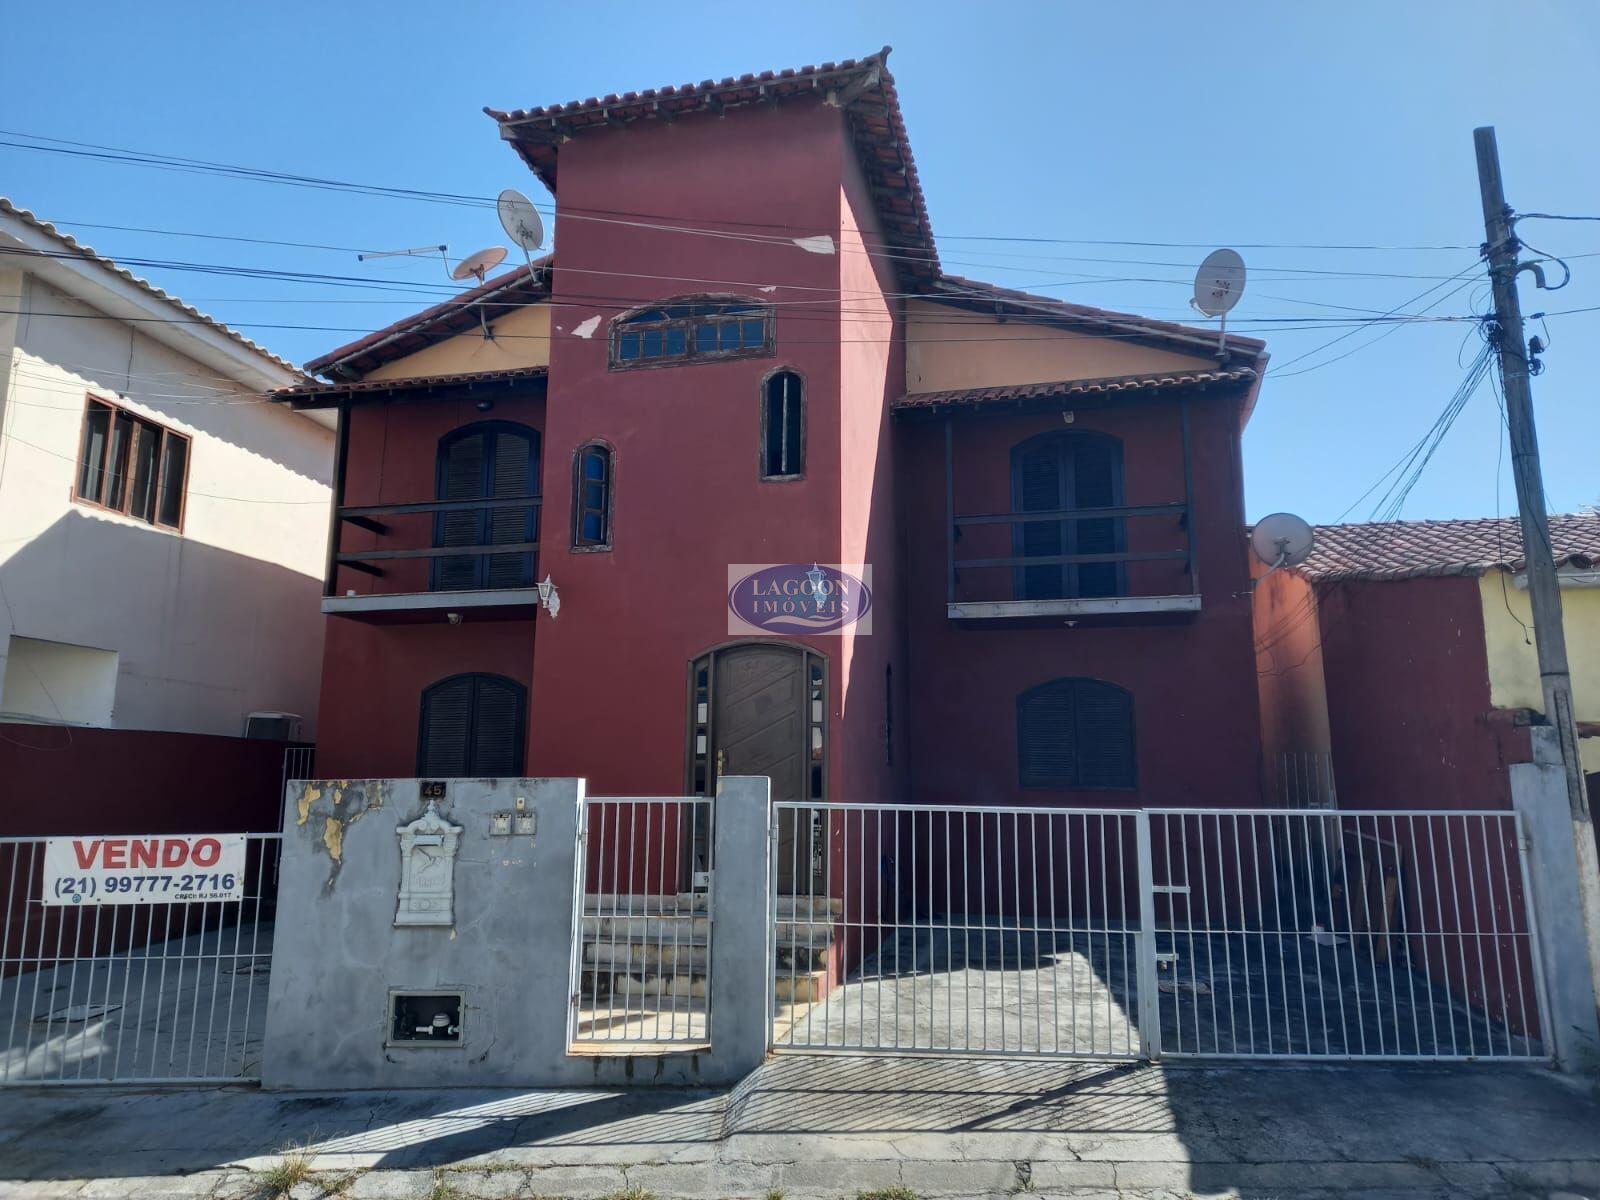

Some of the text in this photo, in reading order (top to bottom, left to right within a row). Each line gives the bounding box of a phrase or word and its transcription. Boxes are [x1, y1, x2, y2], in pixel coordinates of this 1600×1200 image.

[424, 785, 442, 796] 45
[72, 838, 221, 870] VENDO
[54, 873, 235, 898] (21) 99777-2716
